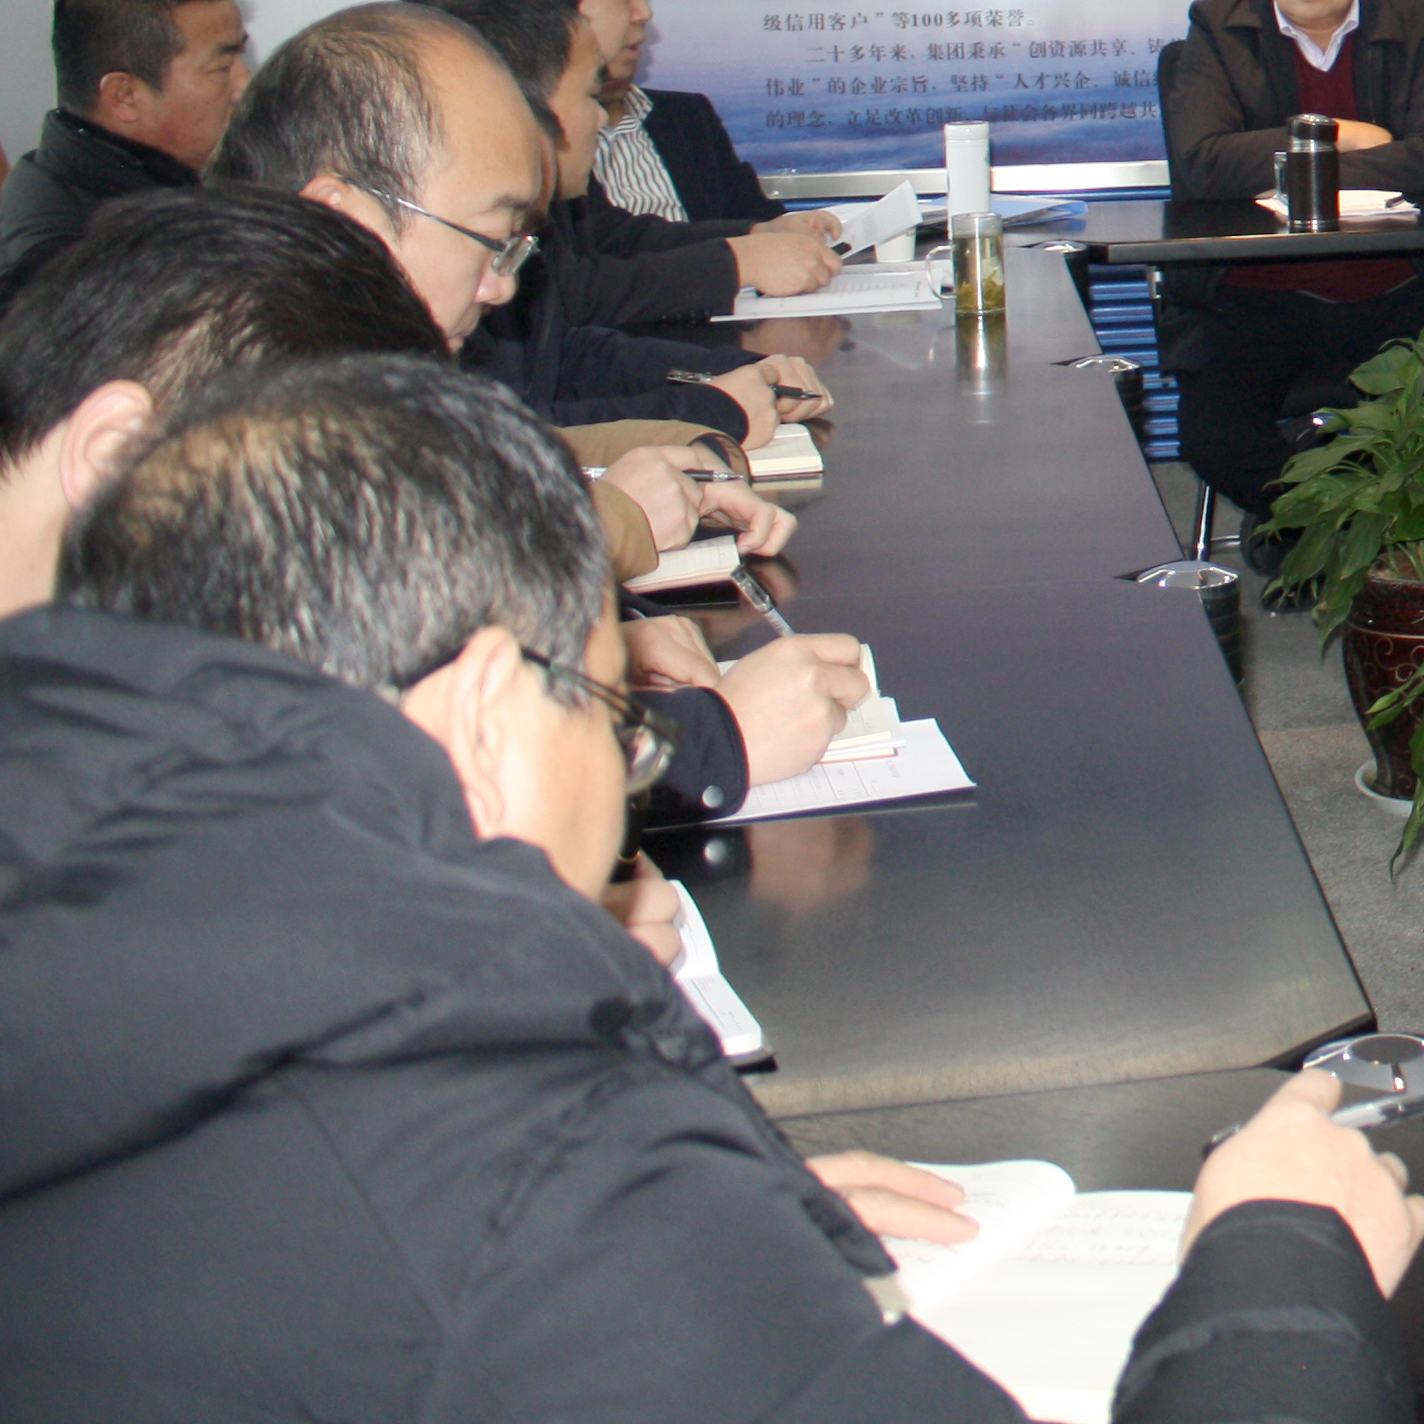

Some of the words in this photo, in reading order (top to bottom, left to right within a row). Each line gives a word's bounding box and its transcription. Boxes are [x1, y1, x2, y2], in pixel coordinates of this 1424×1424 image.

[806, 37, 1184, 63] 二十多年来，集团秉承“创资源共享、铸
[765, 69, 1160, 96] 伟业”的企业宗旨，坚持“人才兴企、诚信
